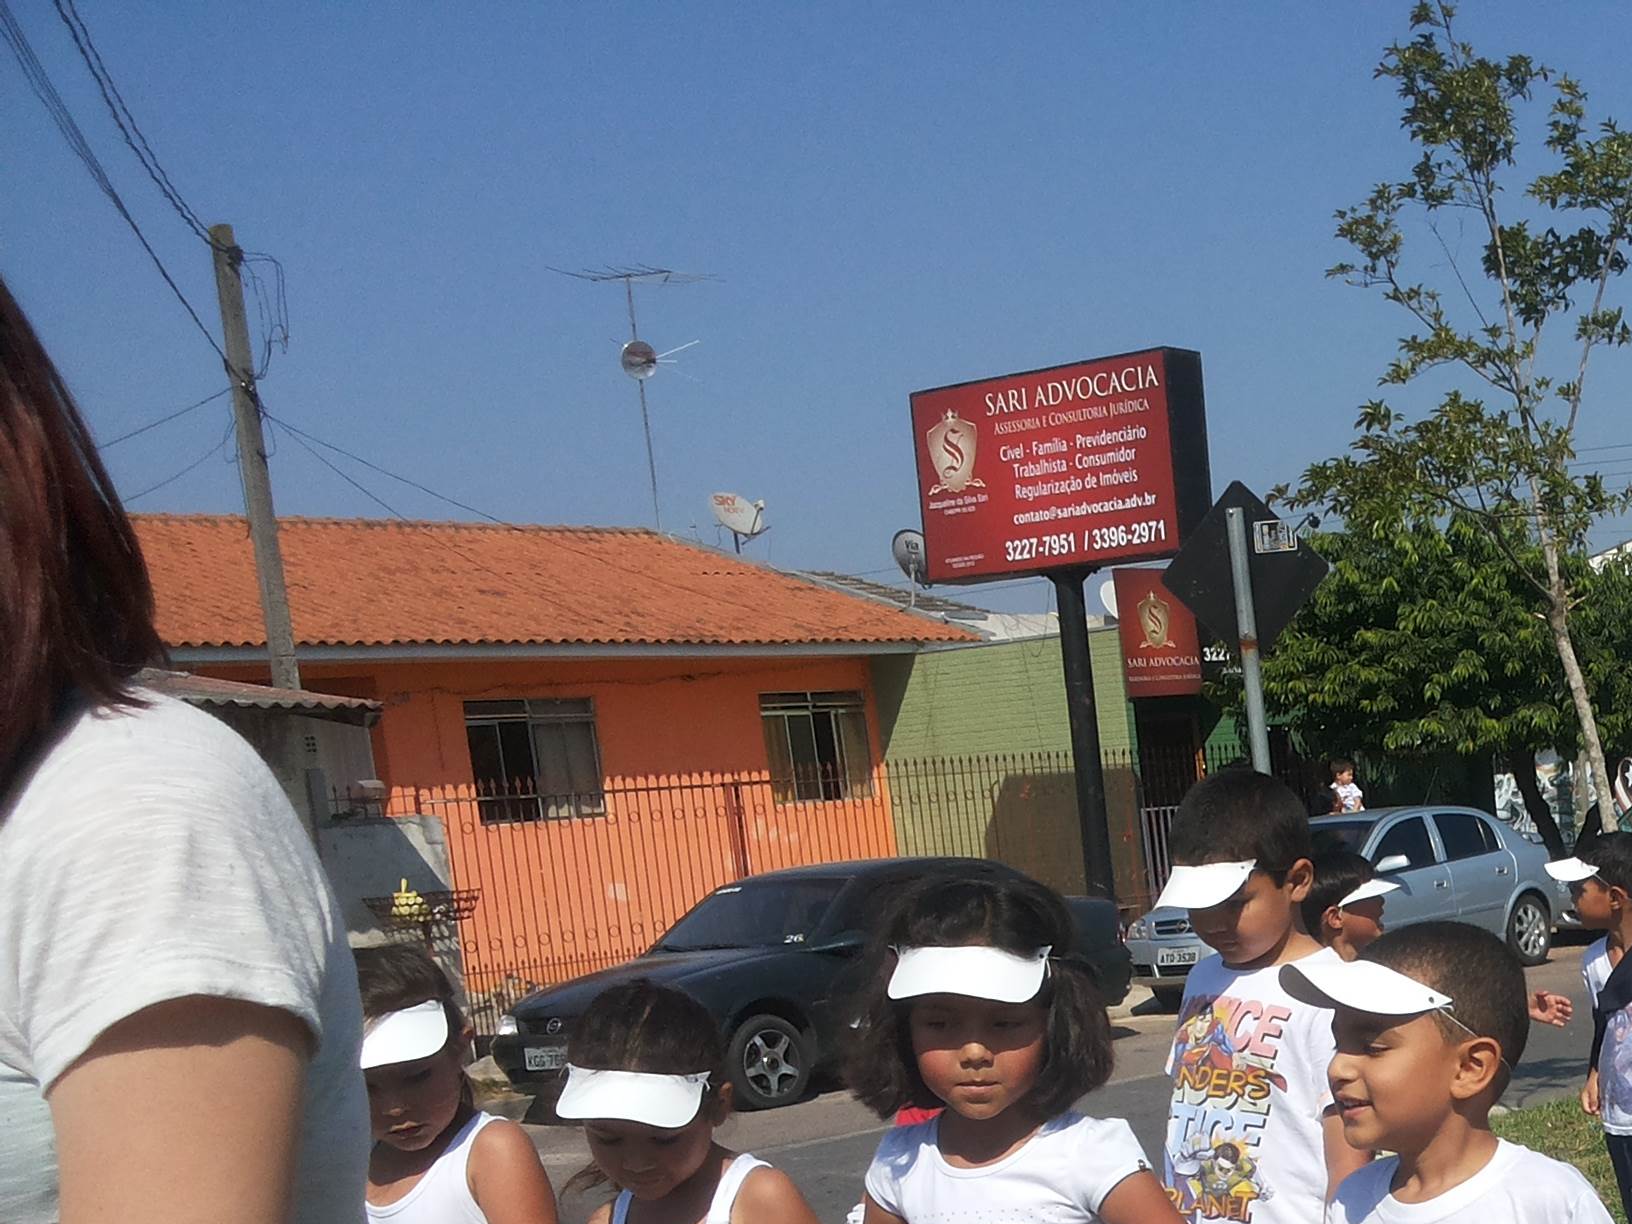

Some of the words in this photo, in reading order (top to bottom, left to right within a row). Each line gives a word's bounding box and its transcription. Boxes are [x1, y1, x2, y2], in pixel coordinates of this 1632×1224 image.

[985, 387, 1028, 416] SARI
[1034, 365, 1159, 408] ADVOCACIA
[1000, 443, 1024, 462] Cível
[1032, 438, 1067, 456] Família
[1076, 425, 1147, 449] Previdenciário
[1013, 460, 1067, 479] Trabalhista
[1075, 447, 1136, 470] Consumidor
[1015, 476, 1082, 502] Regularização
[1085, 473, 1097, 489] de
[1100, 468, 1138, 487] Imóveis
[1013, 492, 1157, 525] contato@sariadvocacia.adv.br
[1005, 532, 1075, 562] 3227-7951
[1092, 519, 1166, 551] 3396-2971
[1127, 656, 1147, 668] SARI
[1149, 655, 1200, 668] ADVOCACIA
